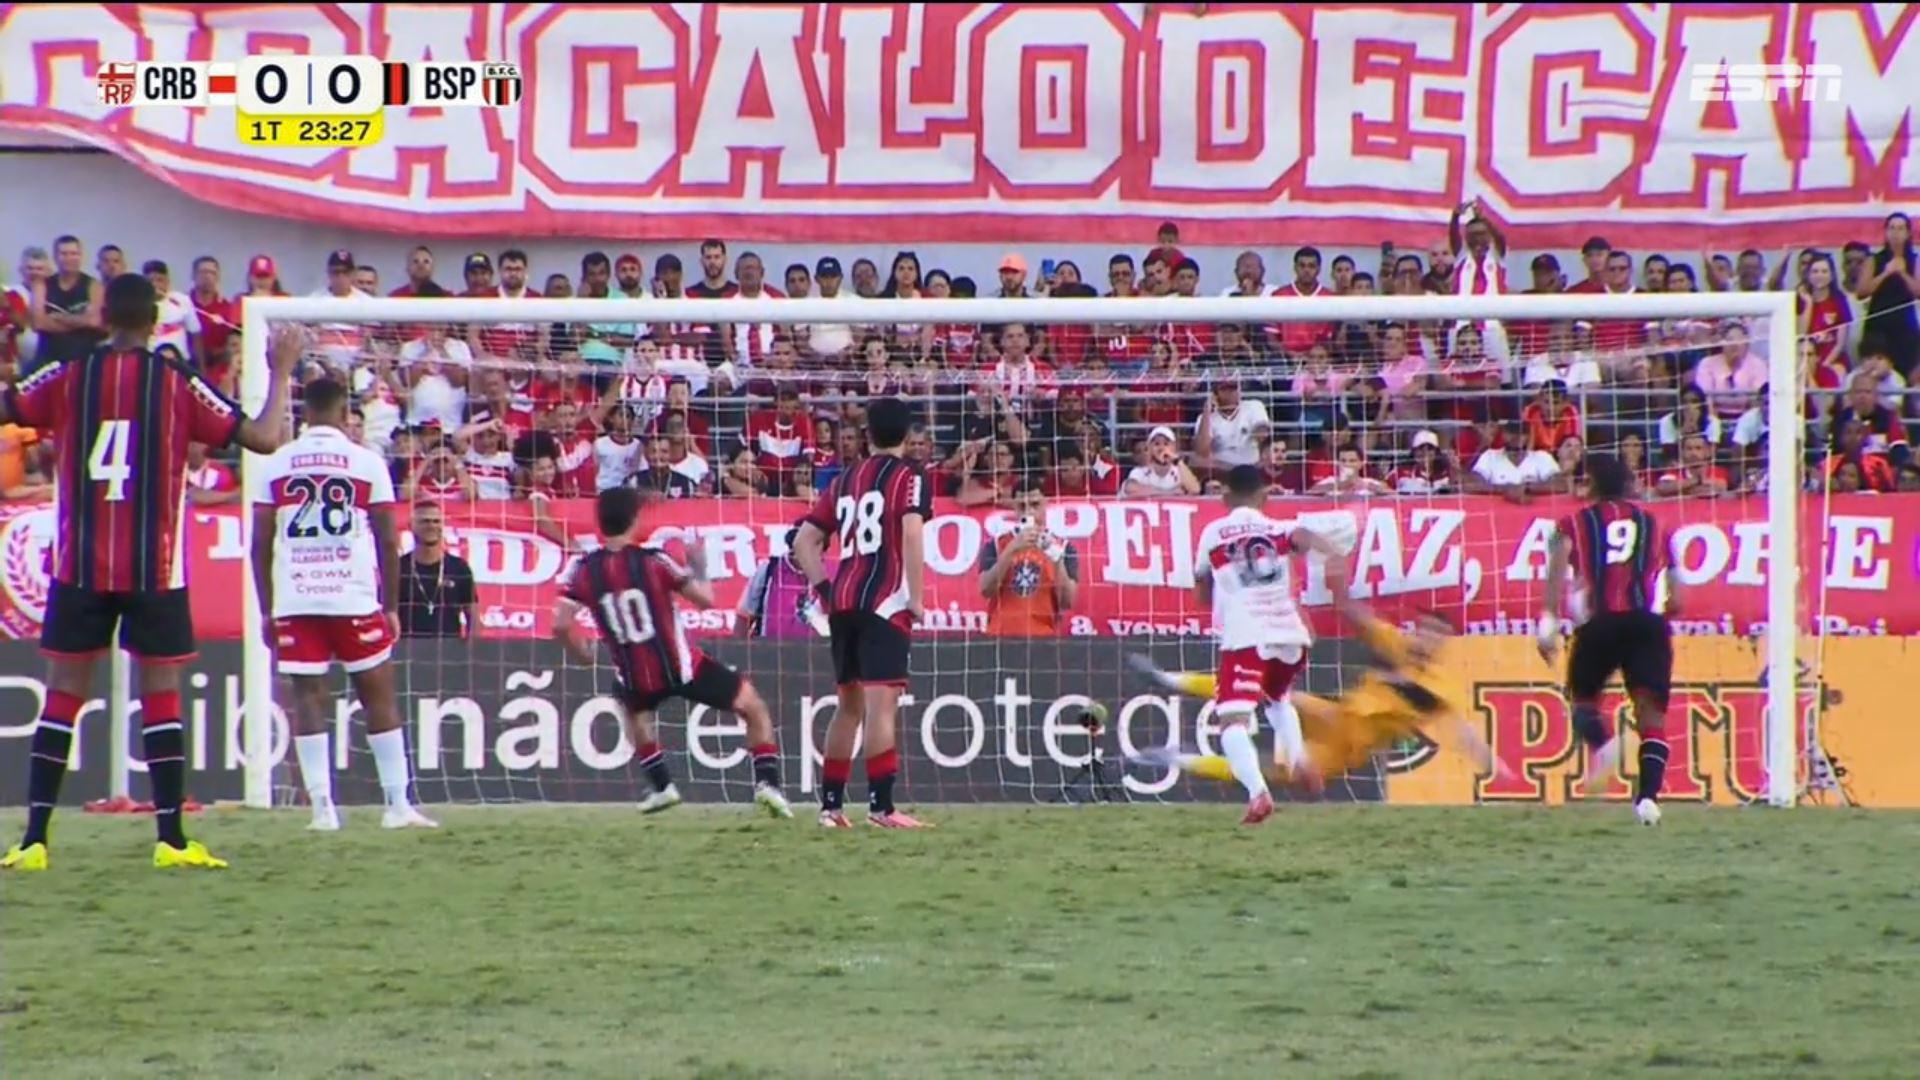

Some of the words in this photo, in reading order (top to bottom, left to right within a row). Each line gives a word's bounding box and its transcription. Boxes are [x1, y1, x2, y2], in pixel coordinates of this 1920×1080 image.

[88, 419, 131, 501] 4
[284, 474, 355, 538] 28
[836, 490, 885, 560] 28
[1505, 517, 1800, 587] AOR
[1825, 515, 1893, 590] E
[1605, 519, 1637, 564] 9
[599, 588, 656, 645] 10
[418, 670, 636, 770] não
